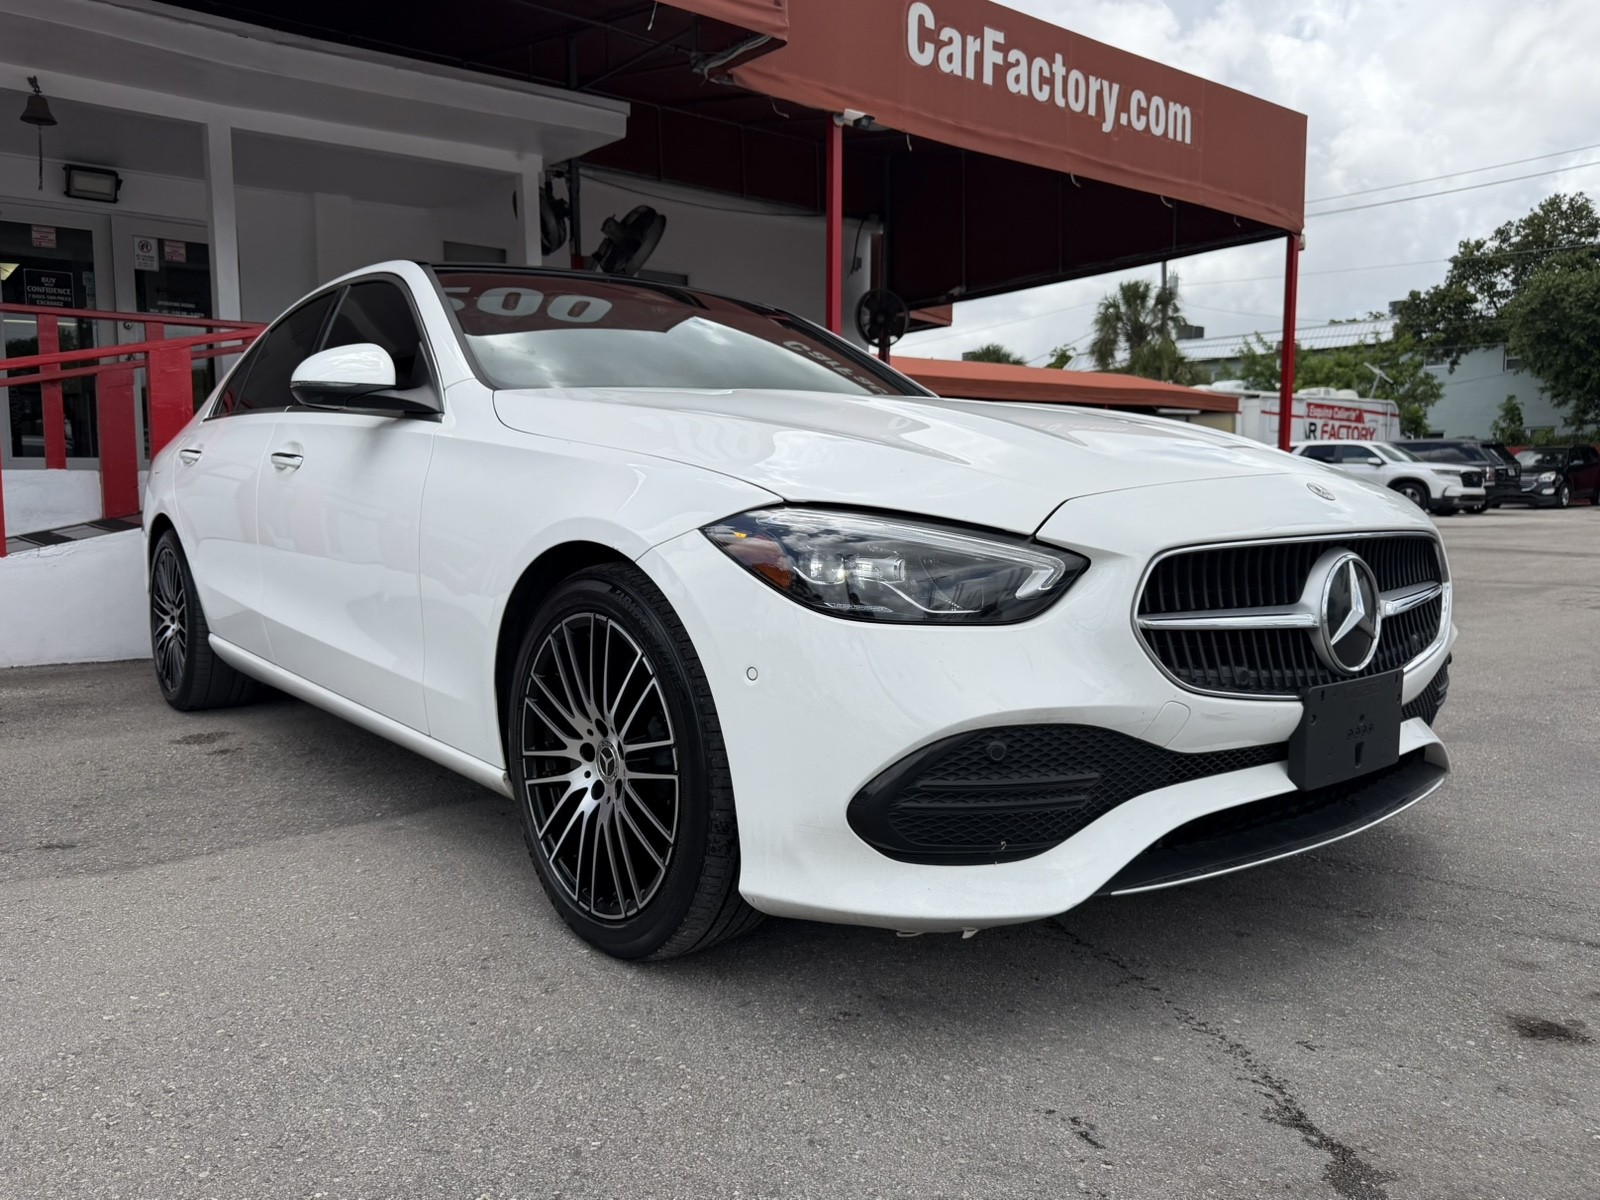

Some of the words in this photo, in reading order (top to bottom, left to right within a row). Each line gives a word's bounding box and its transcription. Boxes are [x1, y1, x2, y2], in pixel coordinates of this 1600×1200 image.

[907, 1, 1192, 144] CarFactory.com
[27, 285, 72, 295] CONFIDENCE
[1320, 423, 1376, 440] FACTORY
